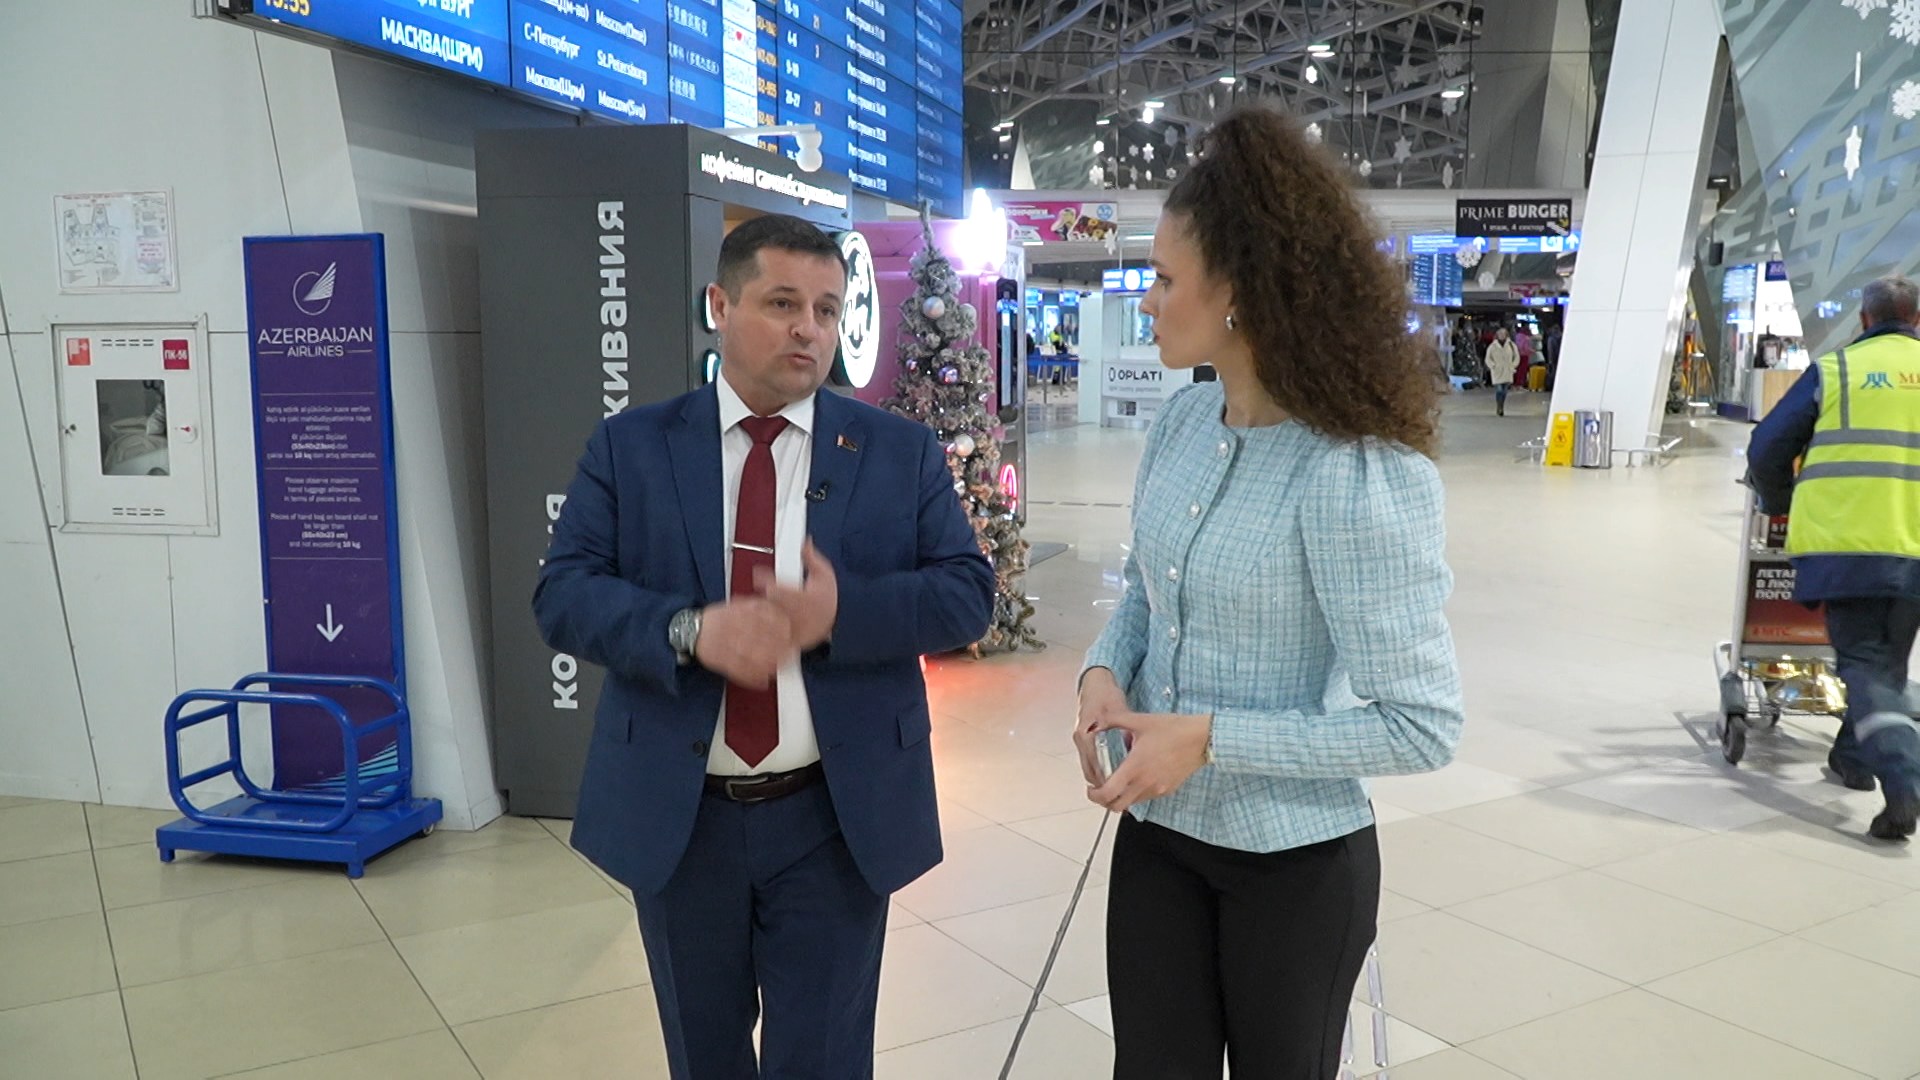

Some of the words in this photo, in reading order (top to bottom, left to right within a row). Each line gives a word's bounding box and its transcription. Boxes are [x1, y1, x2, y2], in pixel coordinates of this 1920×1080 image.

[1459, 206, 1505, 220] PRIME
[1507, 204, 1569, 219] BURGER
[257, 327, 373, 345] AZERBAIJAN
[287, 345, 344, 357] AIRLINES
[1118, 369, 1162, 381] OPLATI
[1755, 589, 1792, 599] ПОГО
